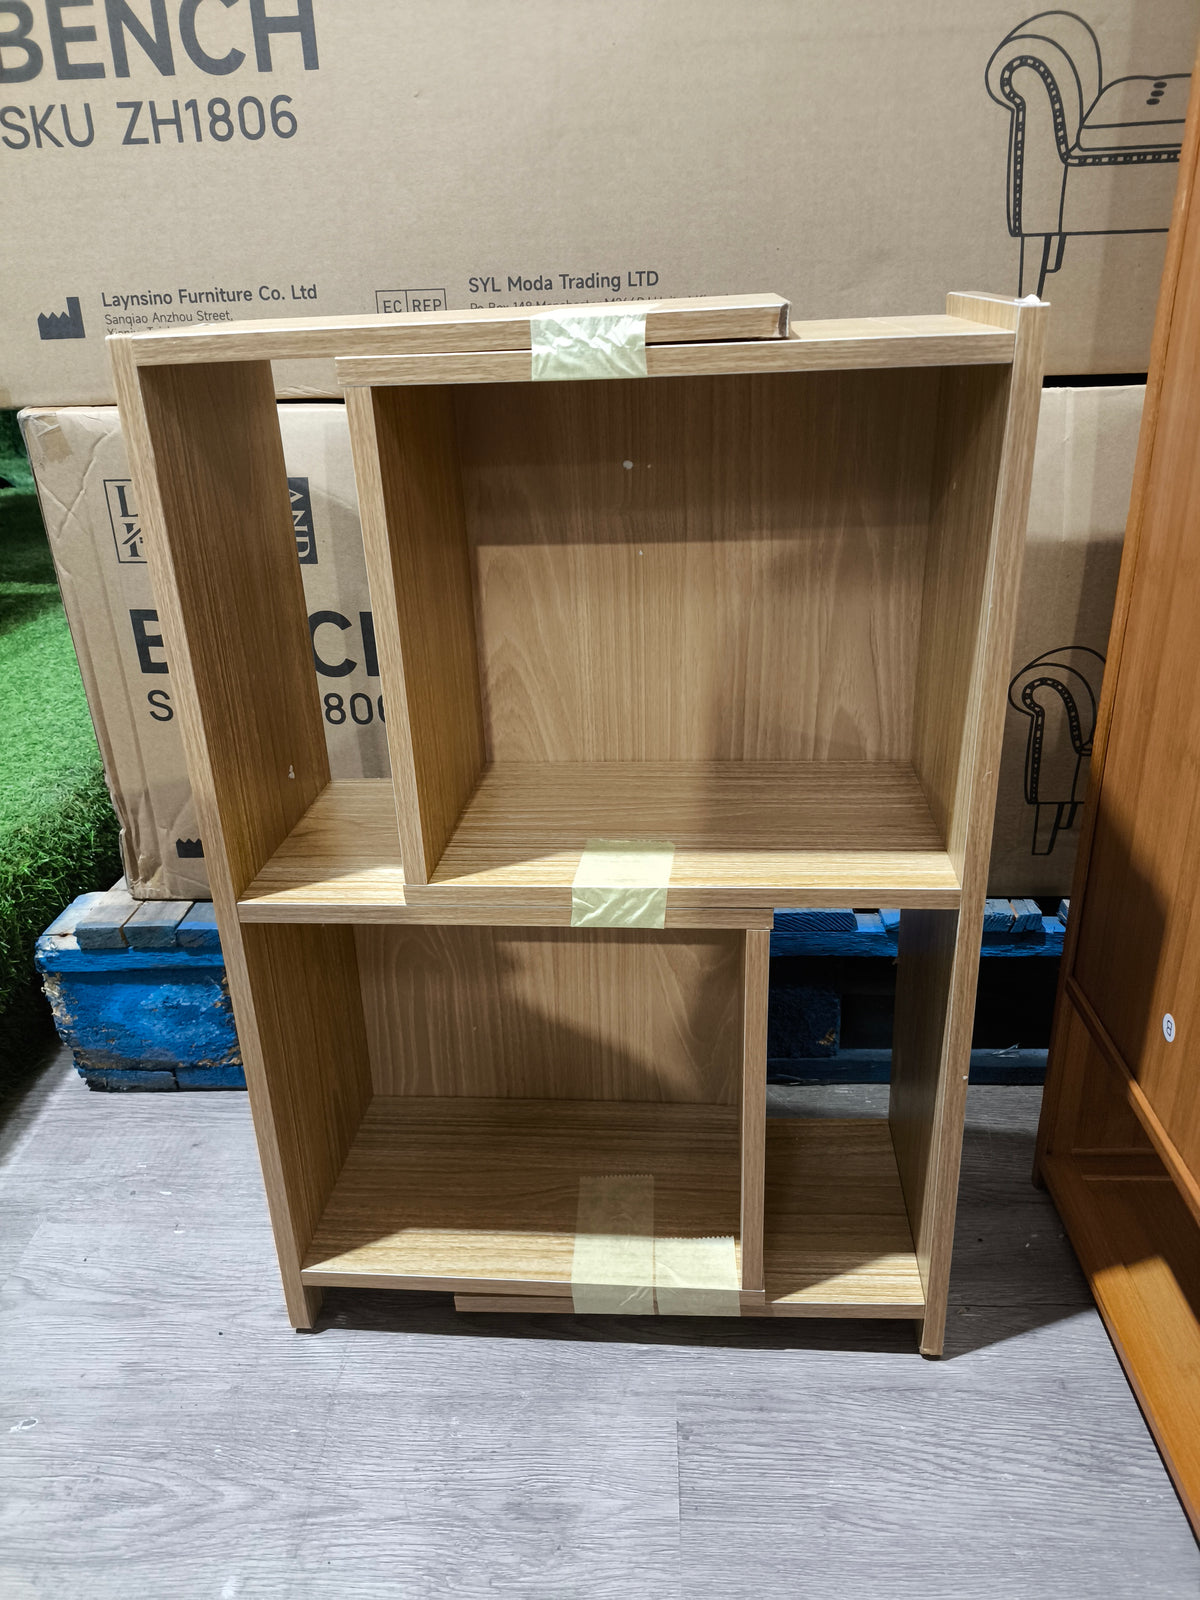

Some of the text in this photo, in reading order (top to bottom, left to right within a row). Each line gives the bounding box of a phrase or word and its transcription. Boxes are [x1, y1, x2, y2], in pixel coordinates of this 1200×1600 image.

[0, 0, 320, 84] BENCH
[1, 94, 298, 150] SKU ZH1806
[468, 270, 659, 293] SYL Moda Trading LTD
[101, 283, 318, 311] Laynsino Furniture Co. Ltd
[383, 298, 442, 313] EC REP
[104, 310, 233, 326] Sanqiao Anzhou Street,
